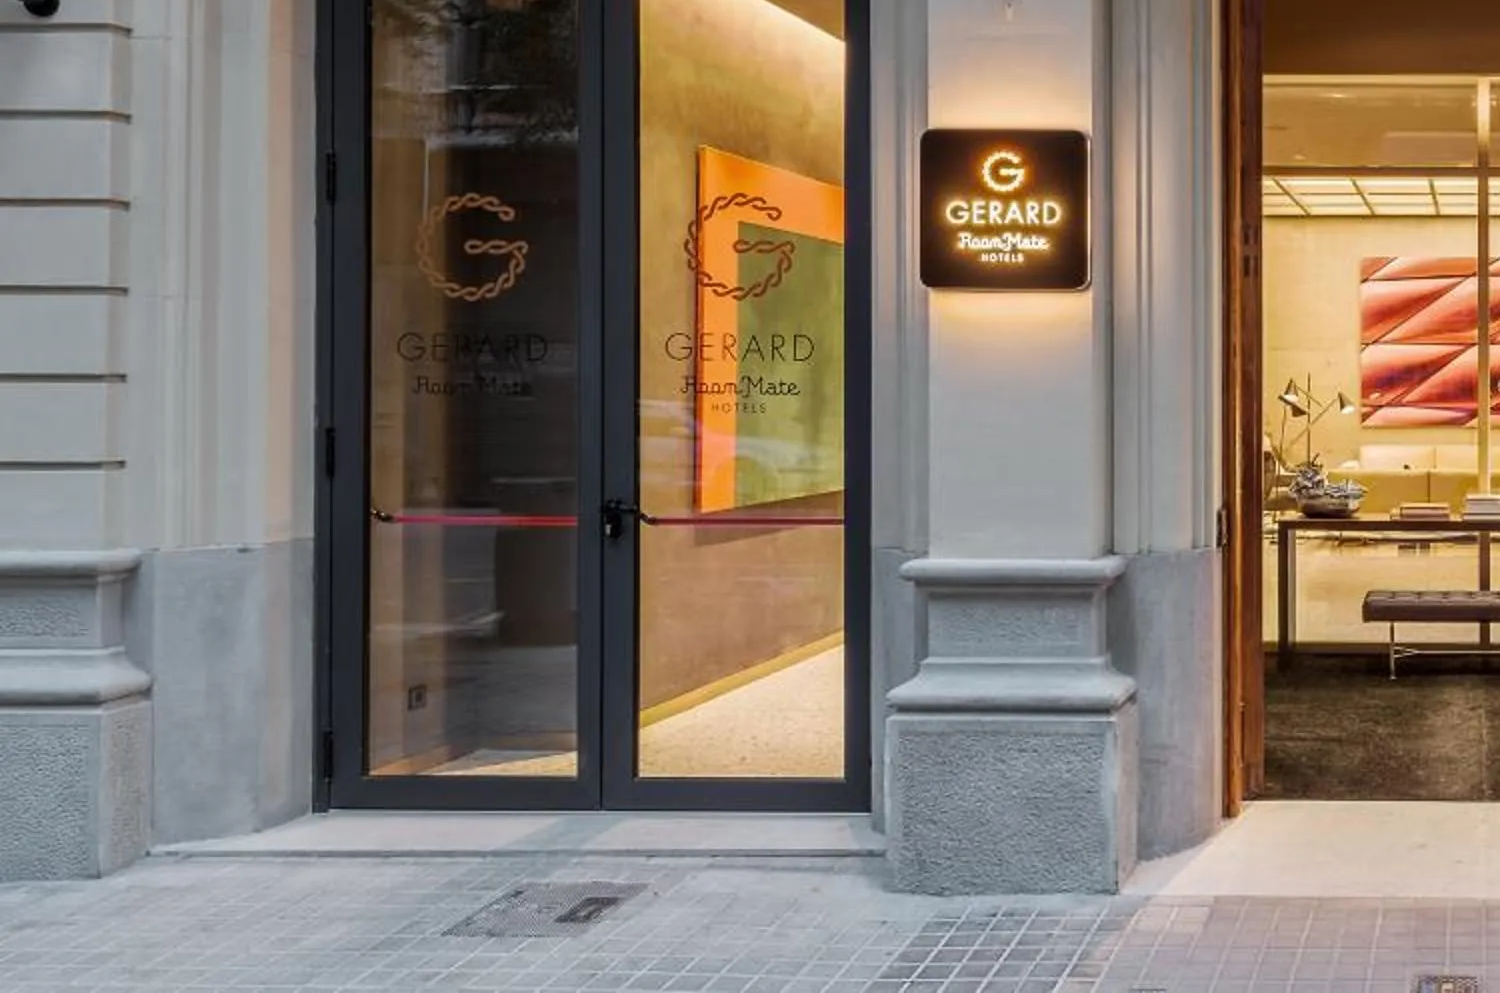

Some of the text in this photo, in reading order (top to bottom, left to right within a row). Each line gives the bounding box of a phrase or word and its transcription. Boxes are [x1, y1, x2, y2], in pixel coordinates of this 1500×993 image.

[982, 151, 1025, 192] G
[945, 201, 1062, 225] GERARD
[981, 253, 1025, 263] HOTELS
[396, 331, 548, 362] GERARD
[665, 332, 815, 361] GERARD
[711, 403, 767, 414] HOTELS
